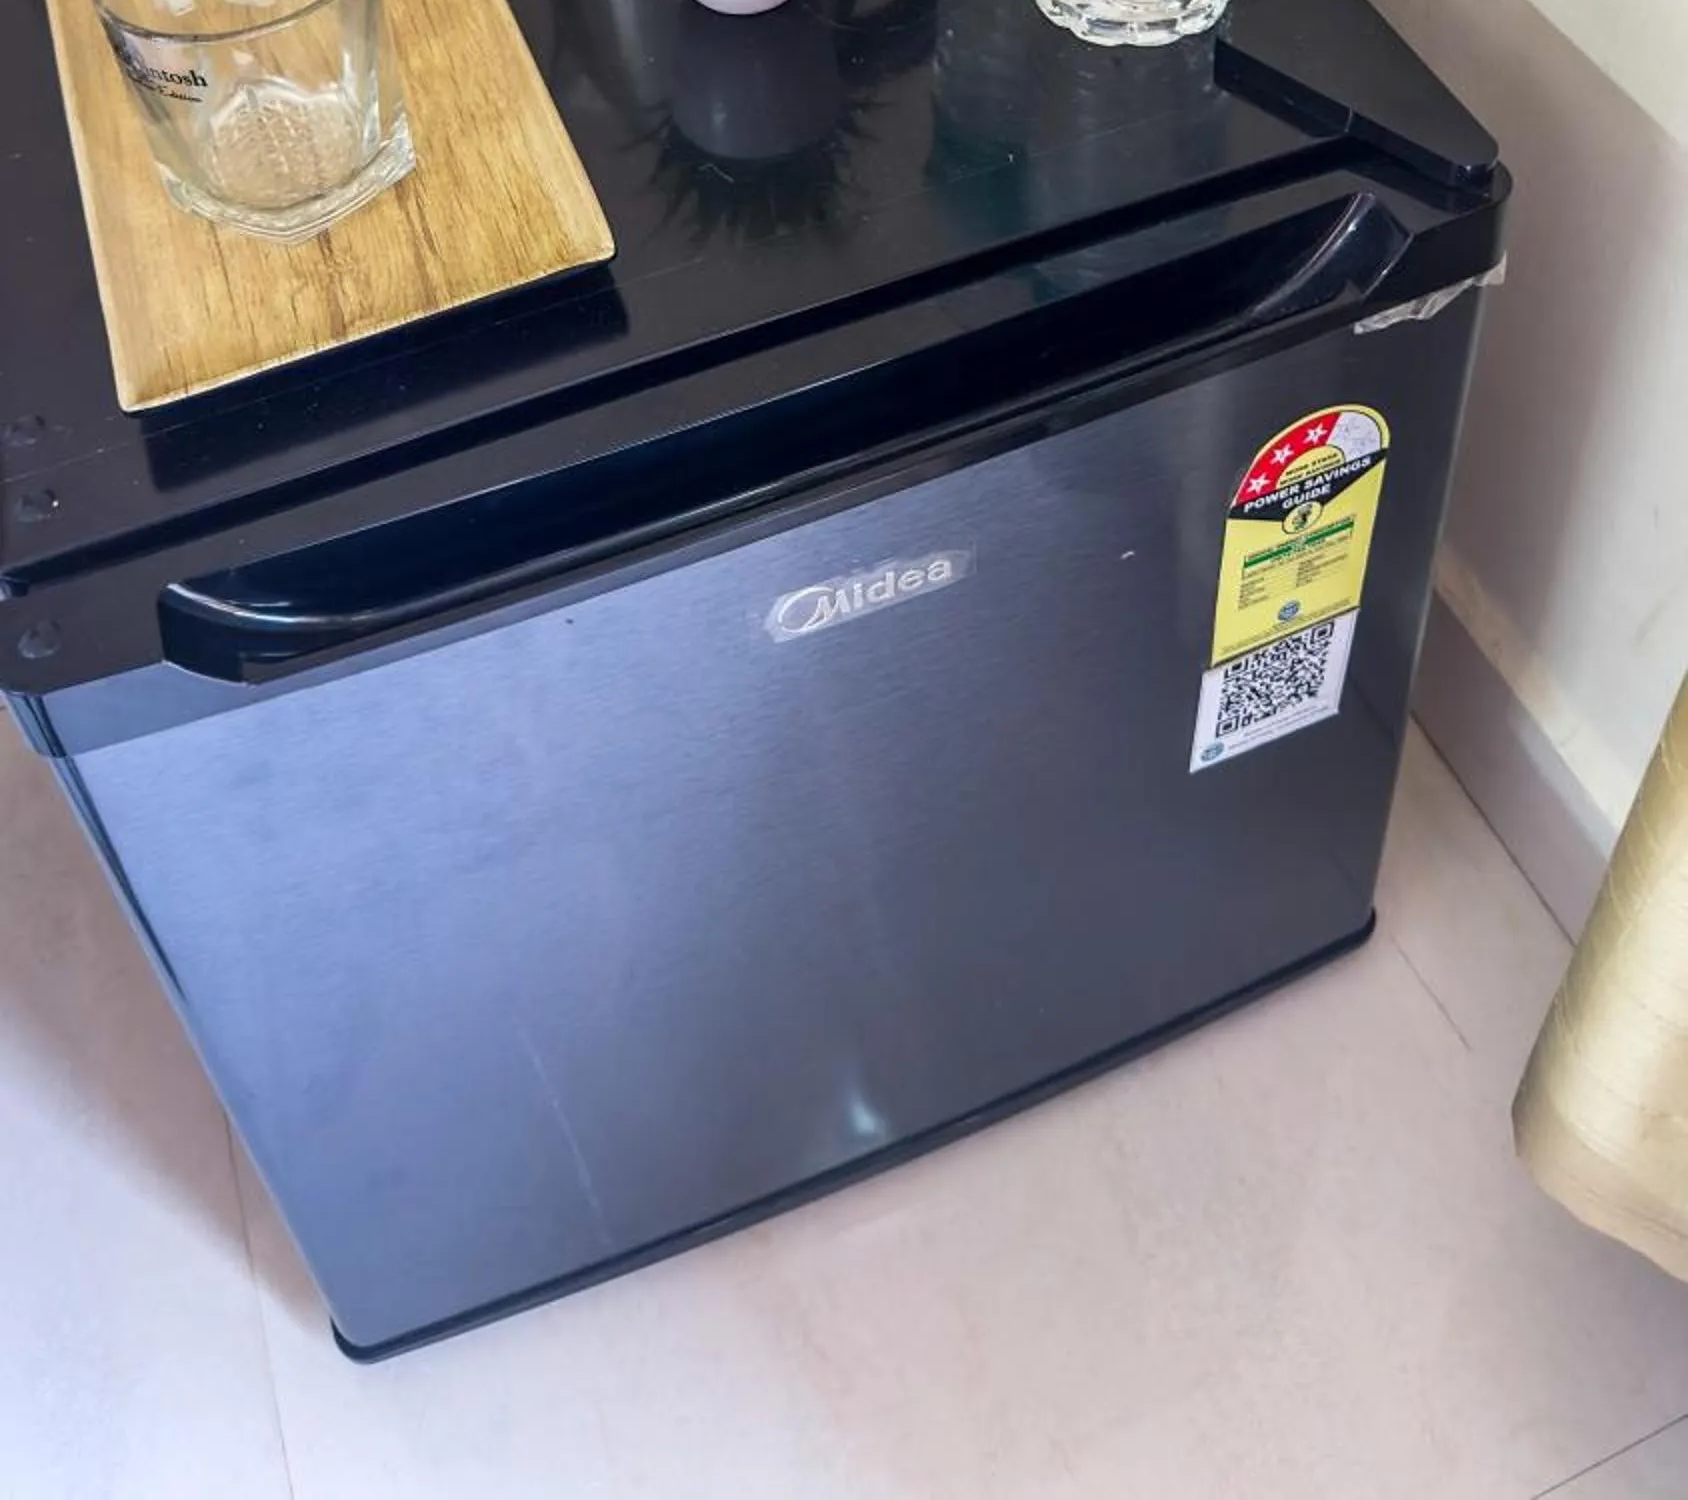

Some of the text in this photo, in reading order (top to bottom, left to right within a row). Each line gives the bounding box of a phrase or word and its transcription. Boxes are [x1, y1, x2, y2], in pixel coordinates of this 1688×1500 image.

[1243, 456, 1372, 513] POWER SAVINGS
[1281, 484, 1332, 510] GUIDE
[778, 557, 954, 633] Midea
